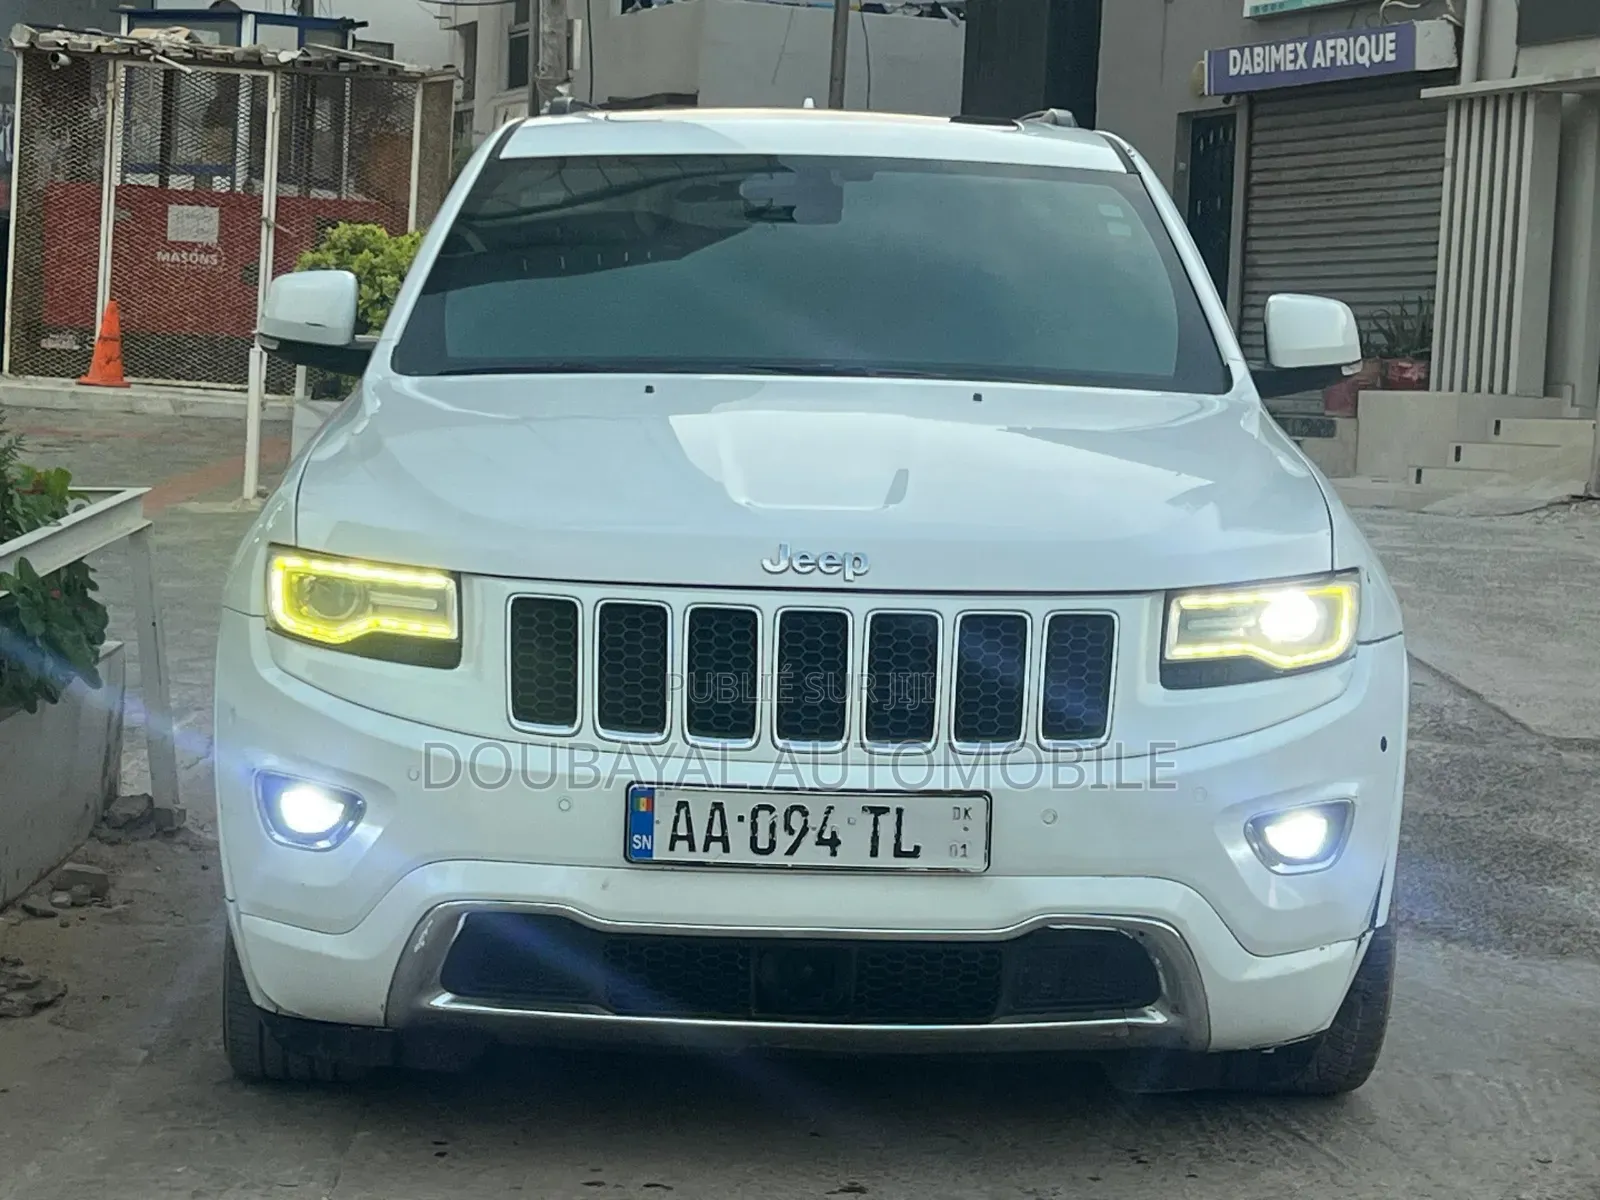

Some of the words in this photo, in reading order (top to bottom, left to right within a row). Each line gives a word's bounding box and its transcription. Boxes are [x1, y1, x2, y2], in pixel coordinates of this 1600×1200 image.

[1228, 41, 1308, 77] DABIMEX
[1312, 31, 1397, 69] AFRIQUE
[156, 251, 218, 266] MASONS
[761, 541, 870, 582] Jeep
[952, 805, 973, 821] DK
[632, 835, 652, 850] SN
